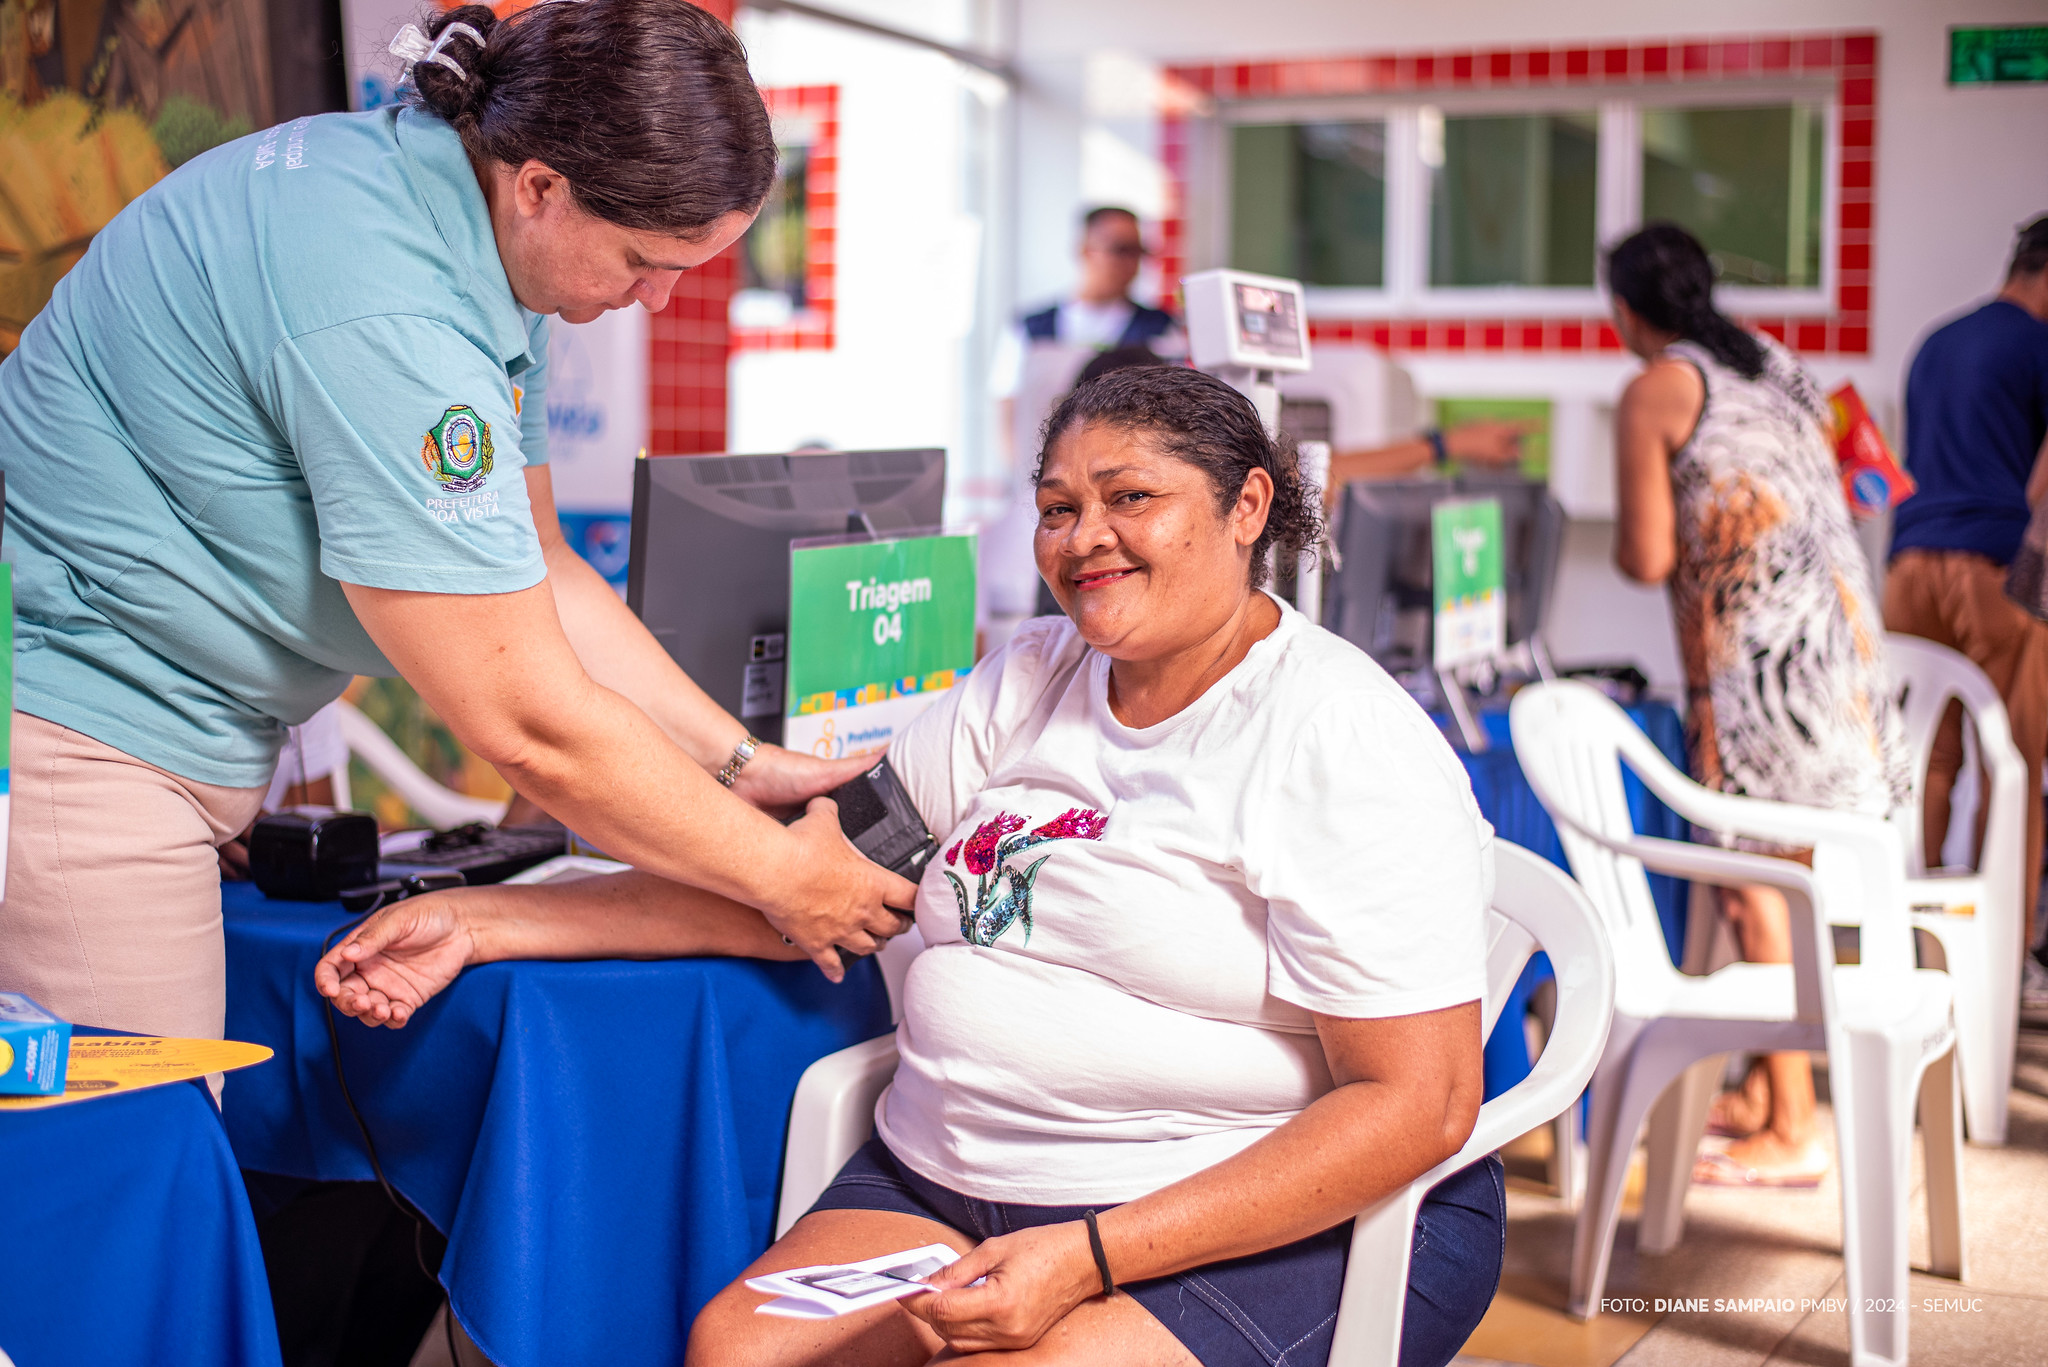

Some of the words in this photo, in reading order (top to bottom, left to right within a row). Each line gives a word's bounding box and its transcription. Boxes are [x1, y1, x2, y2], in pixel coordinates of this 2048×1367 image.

[427, 491, 499, 509] PREFEITURA
[464, 502, 500, 520] VISTA
[846, 577, 932, 612] Triagem
[873, 612, 903, 645] 04
